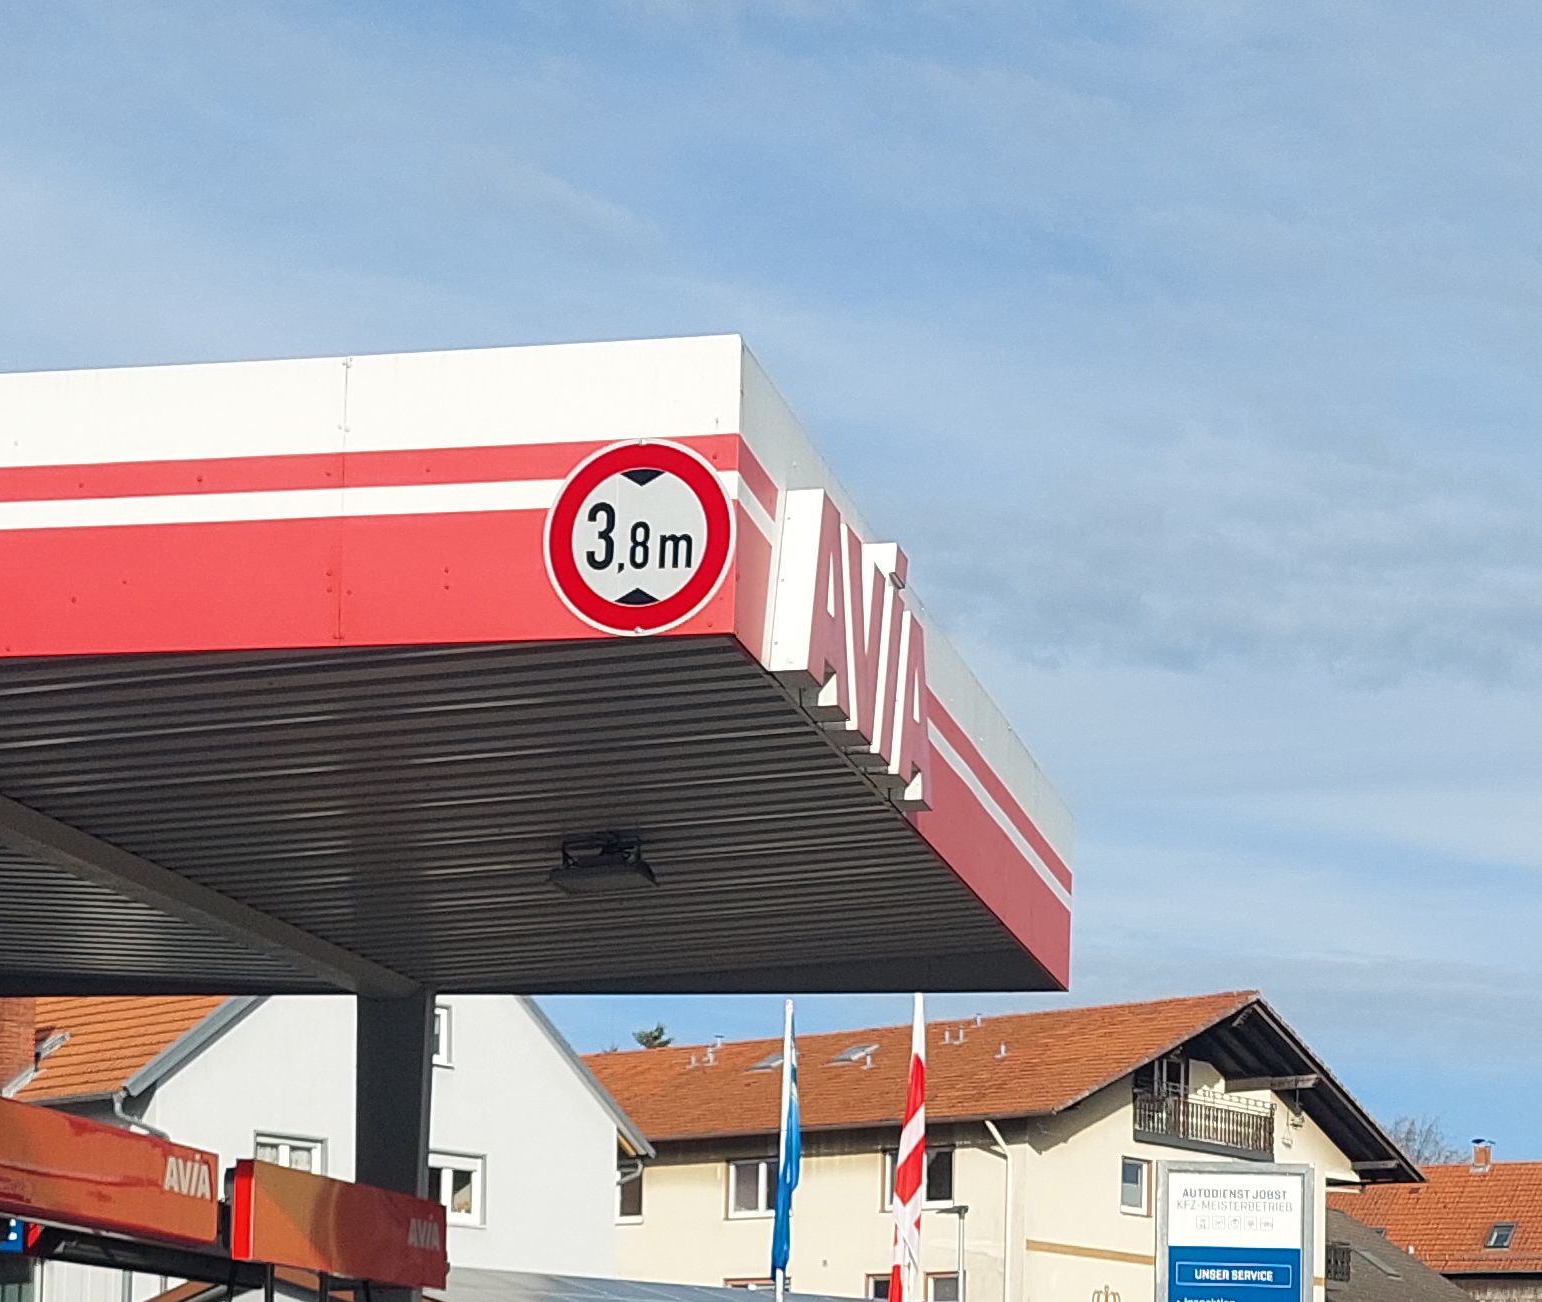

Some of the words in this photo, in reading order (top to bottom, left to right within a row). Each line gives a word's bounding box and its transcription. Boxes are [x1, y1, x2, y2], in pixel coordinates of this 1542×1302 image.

[789, 488, 932, 811] AVIA
[163, 1153, 211, 1200] AVIA
[1176, 1199, 1293, 1212] KFZ-MEISTERBETRIEB
[1182, 1187, 1250, 1200] AUTODIENST
[1252, 1189, 1287, 1200] JOBST
[407, 1214, 440, 1250] AVIA
[1194, 1268, 1229, 1280] UNSER
[1231, 1269, 1273, 1282] SERVICE
